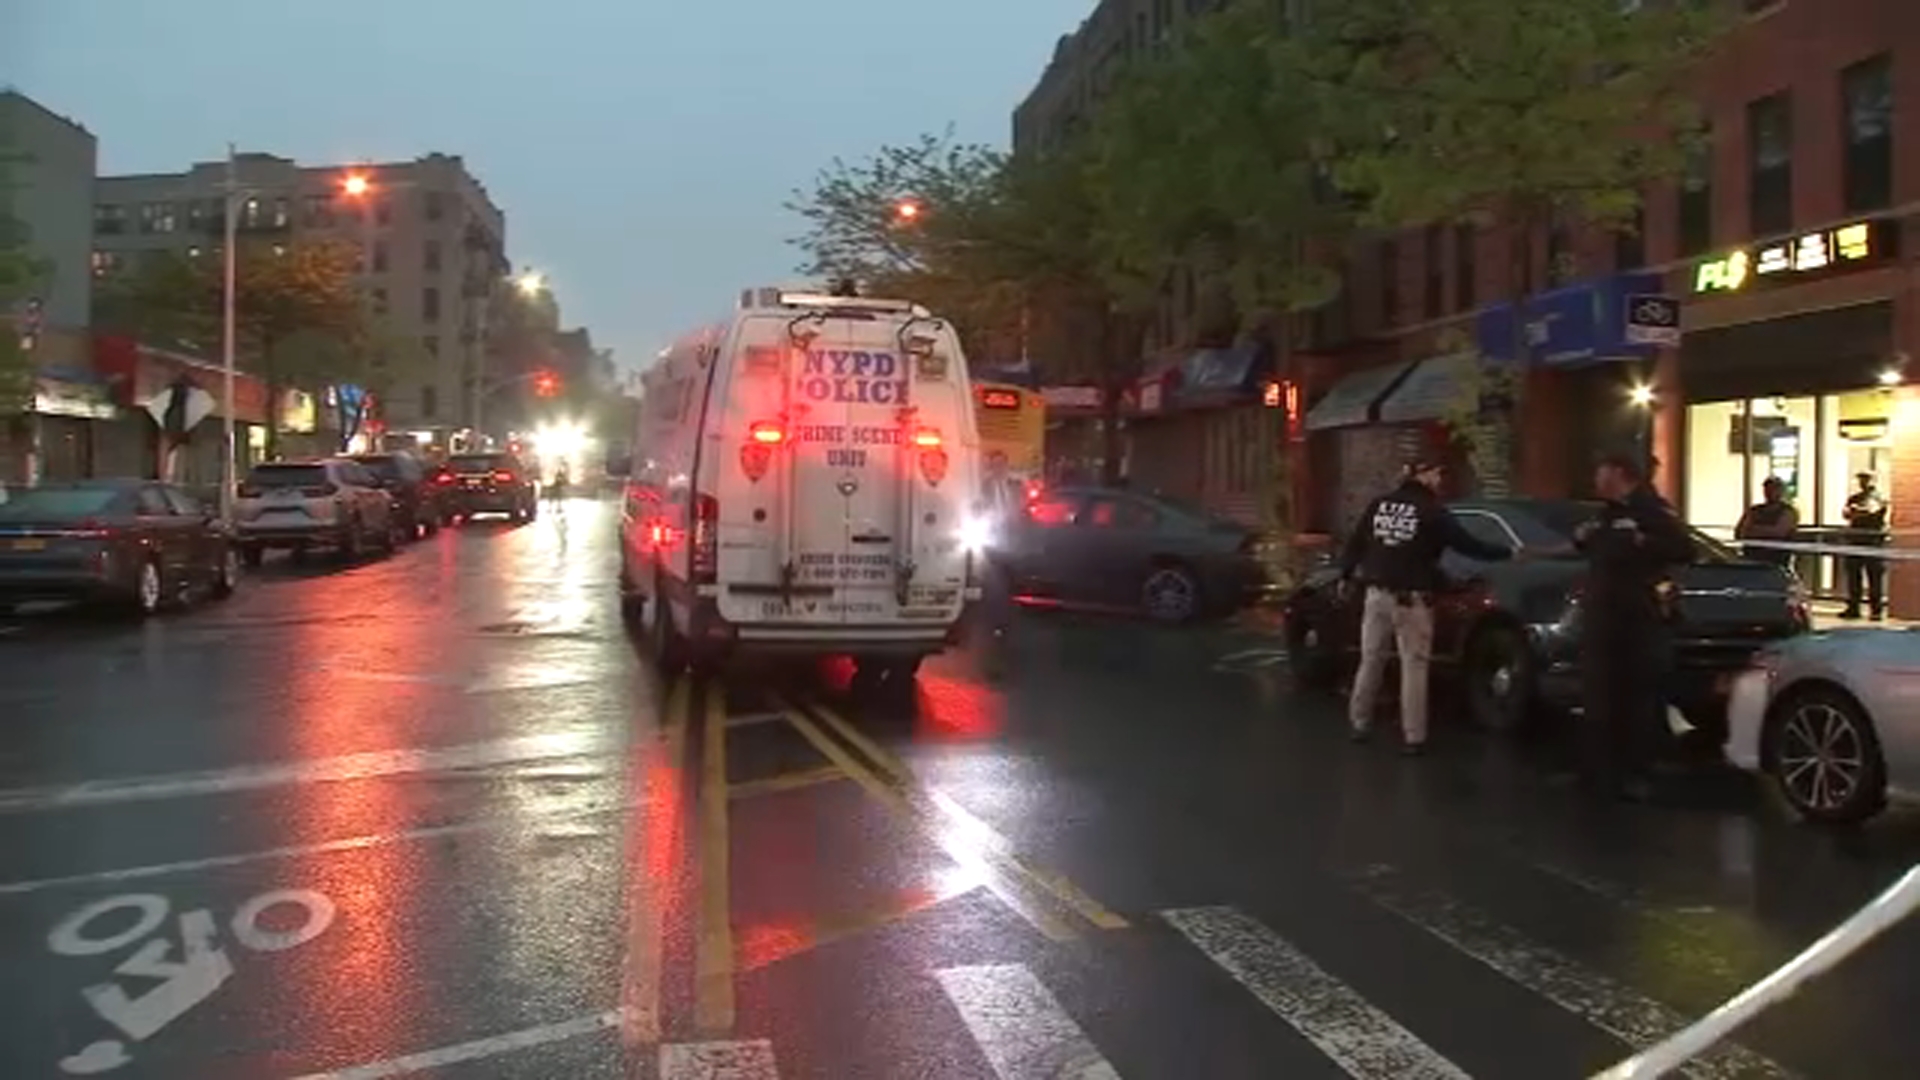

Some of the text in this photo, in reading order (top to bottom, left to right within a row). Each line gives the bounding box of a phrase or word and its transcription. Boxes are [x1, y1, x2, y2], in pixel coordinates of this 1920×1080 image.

[804, 350, 895, 377] NYPD
[797, 378, 909, 405] OLICE
[827, 449, 867, 468] UNIT
